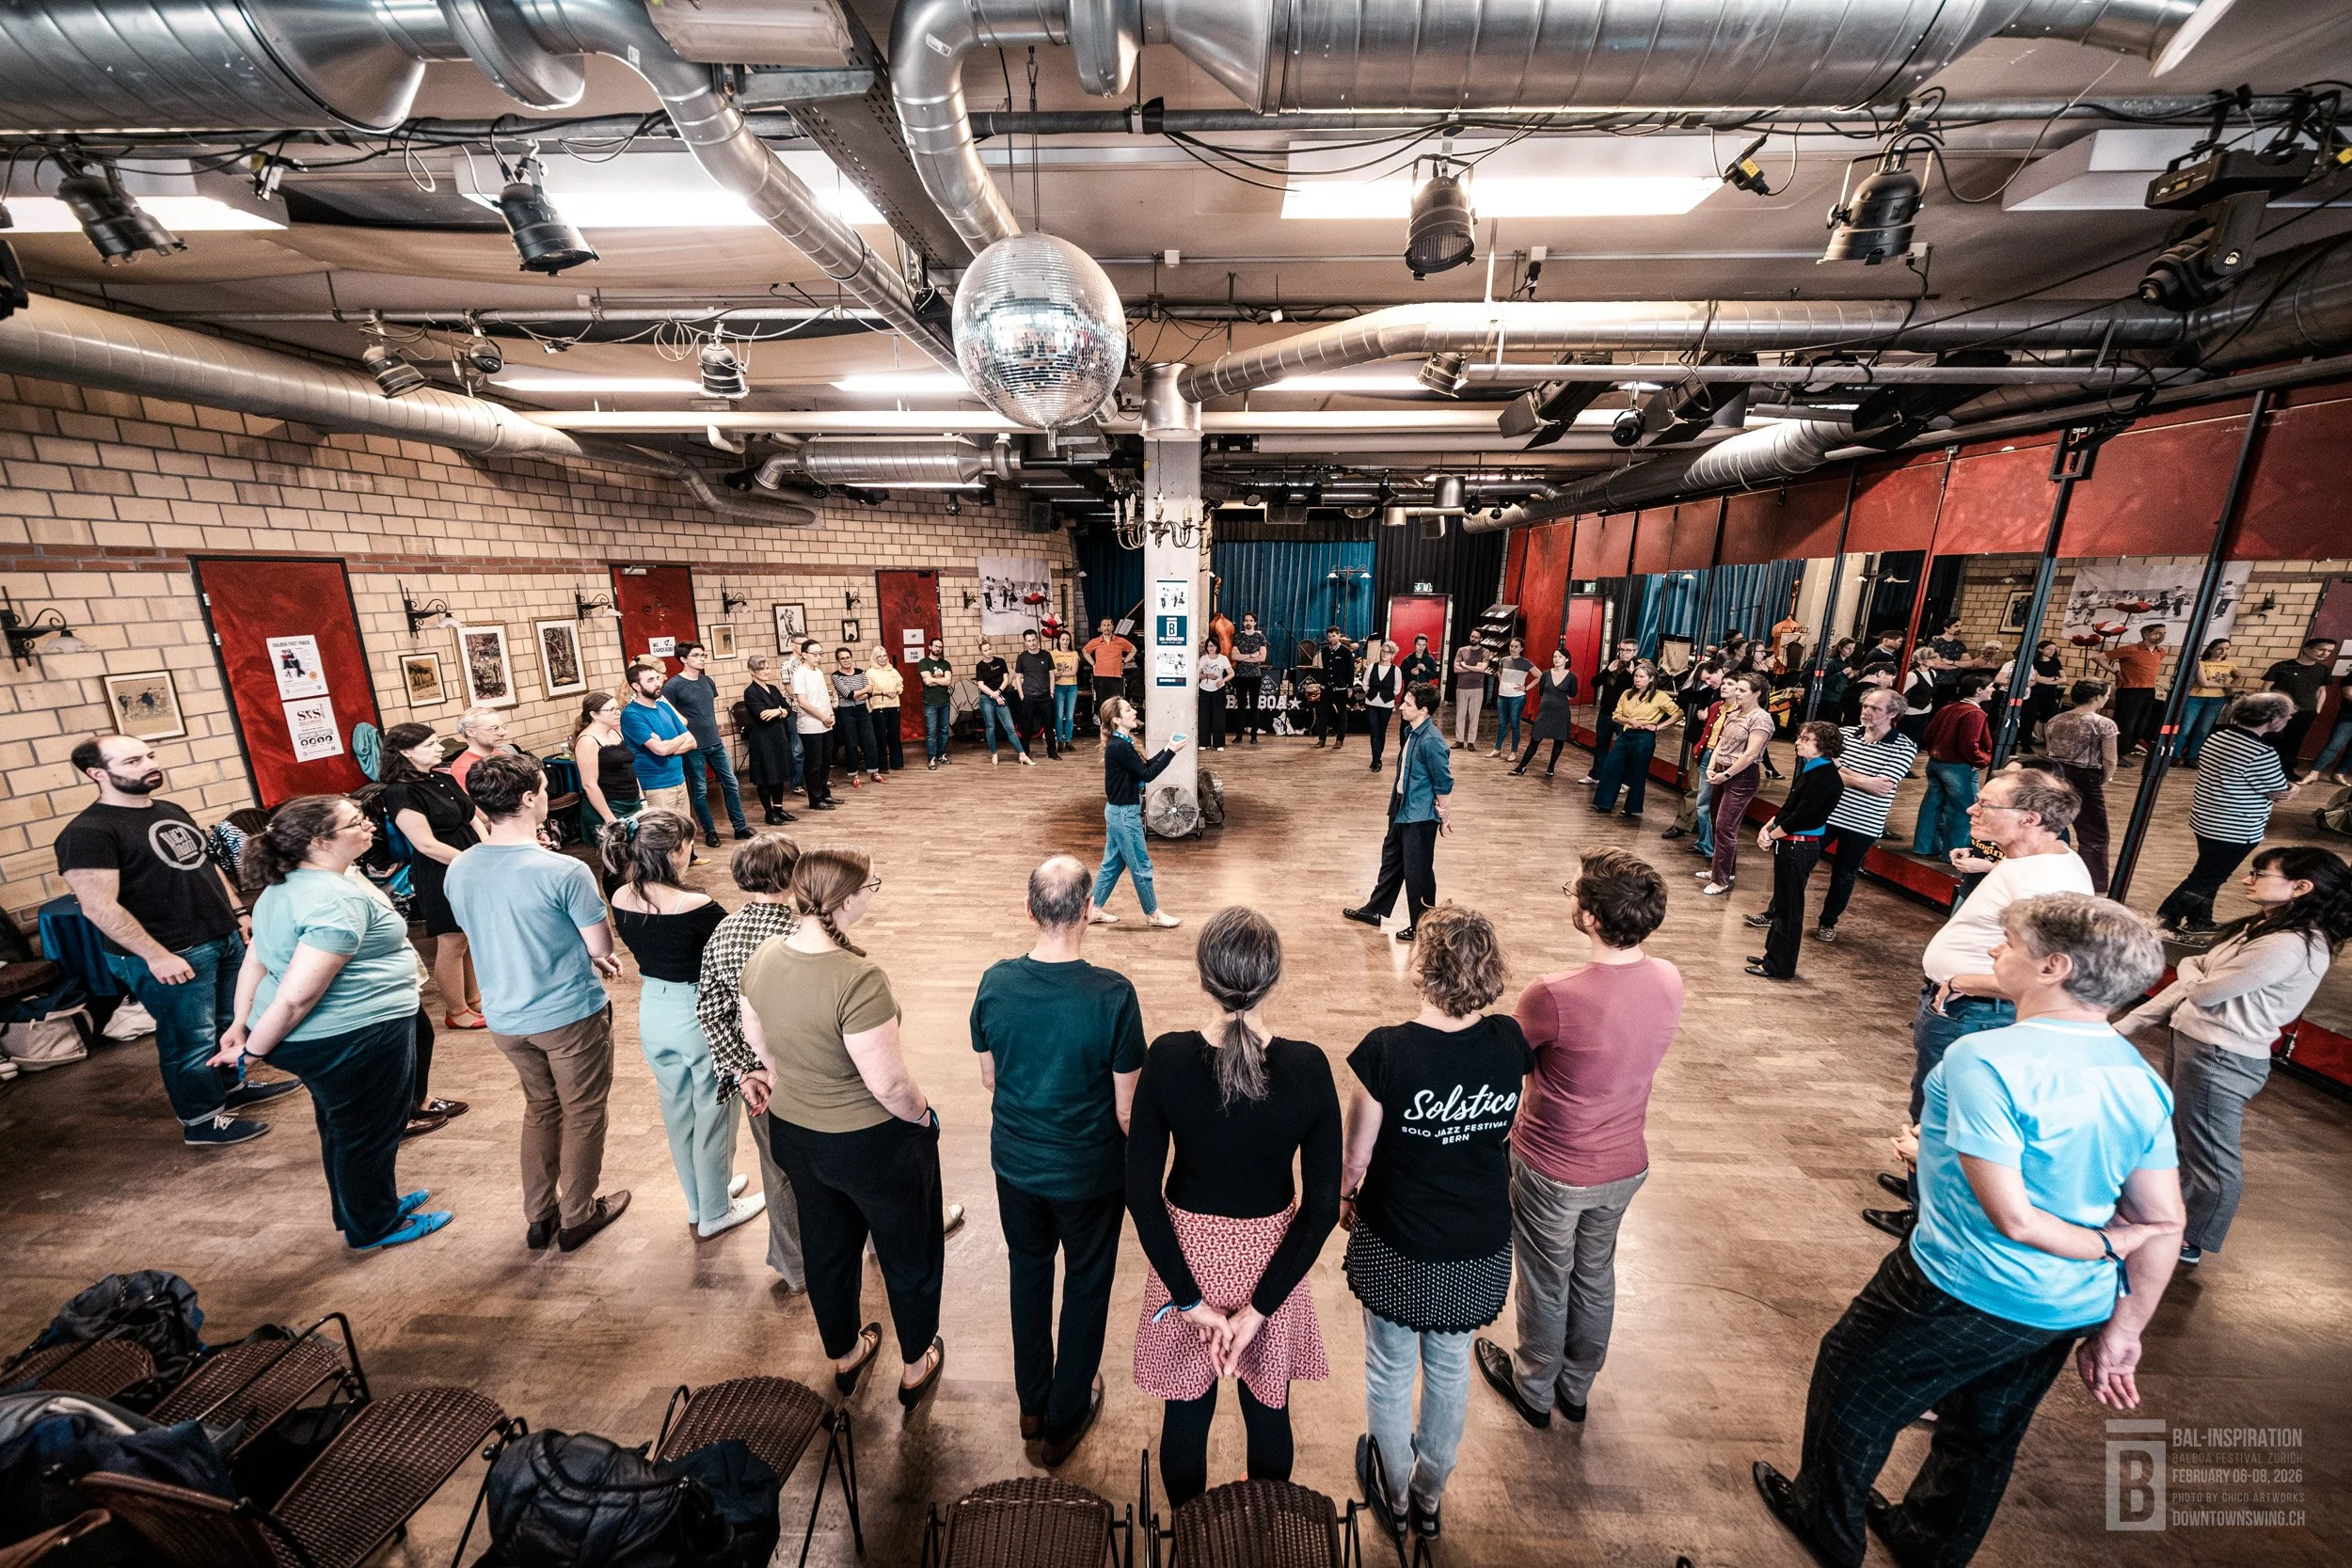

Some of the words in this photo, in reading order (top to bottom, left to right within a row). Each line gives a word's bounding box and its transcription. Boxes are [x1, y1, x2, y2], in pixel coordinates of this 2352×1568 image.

[1168, 623, 1175, 634] B
[1404, 1085, 1518, 1122] Solstice
[1402, 1126, 1431, 1137] SOLO
[1435, 1126, 1460, 1137] JAZZ
[1464, 1120, 1507, 1132] FESTIVAL
[1442, 1133, 1470, 1145] BERN
